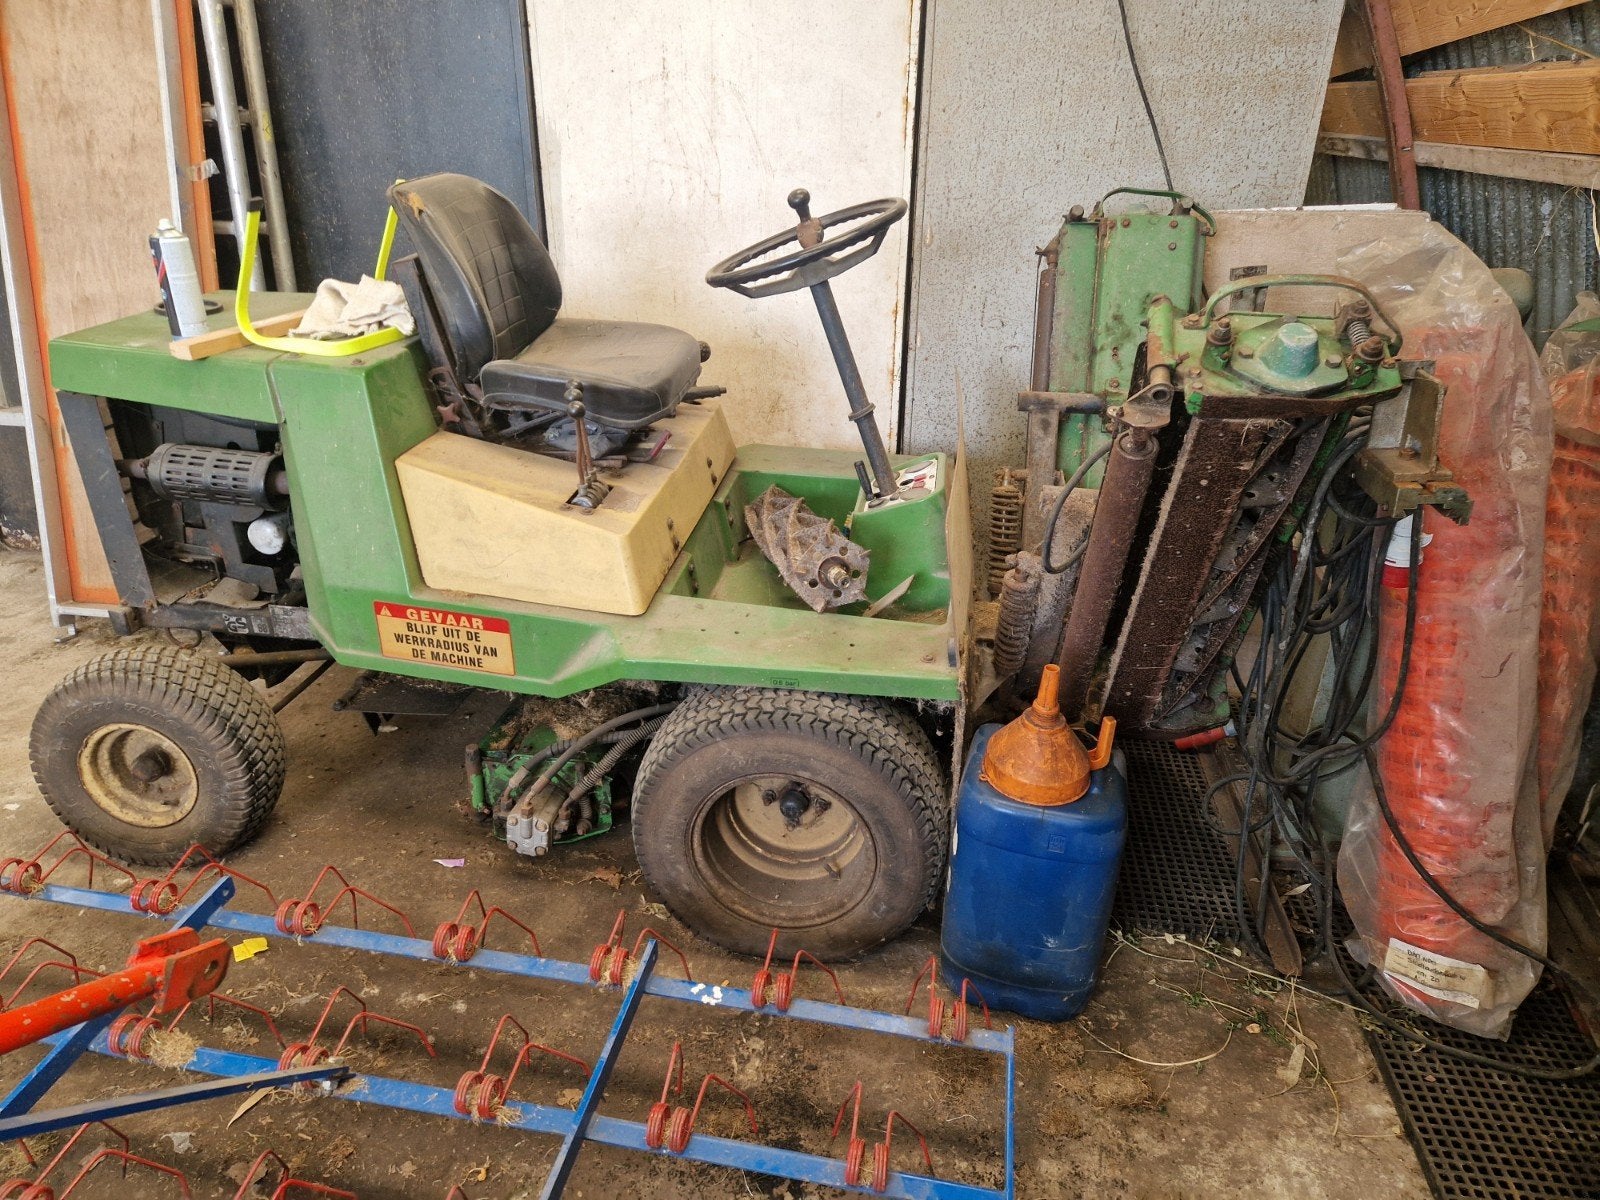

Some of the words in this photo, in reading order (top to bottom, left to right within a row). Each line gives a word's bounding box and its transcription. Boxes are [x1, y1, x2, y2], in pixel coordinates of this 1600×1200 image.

[406, 609, 484, 630] GEVAAR
[406, 622, 438, 636] BLIJF
[442, 627, 462, 639] UIT
[466, 631, 481, 643] DE
[393, 633, 470, 654] WERKRADIUS
[474, 646, 498, 658] VAN
[412, 648, 427, 660] DE
[431, 652, 484, 668] MACHINE
